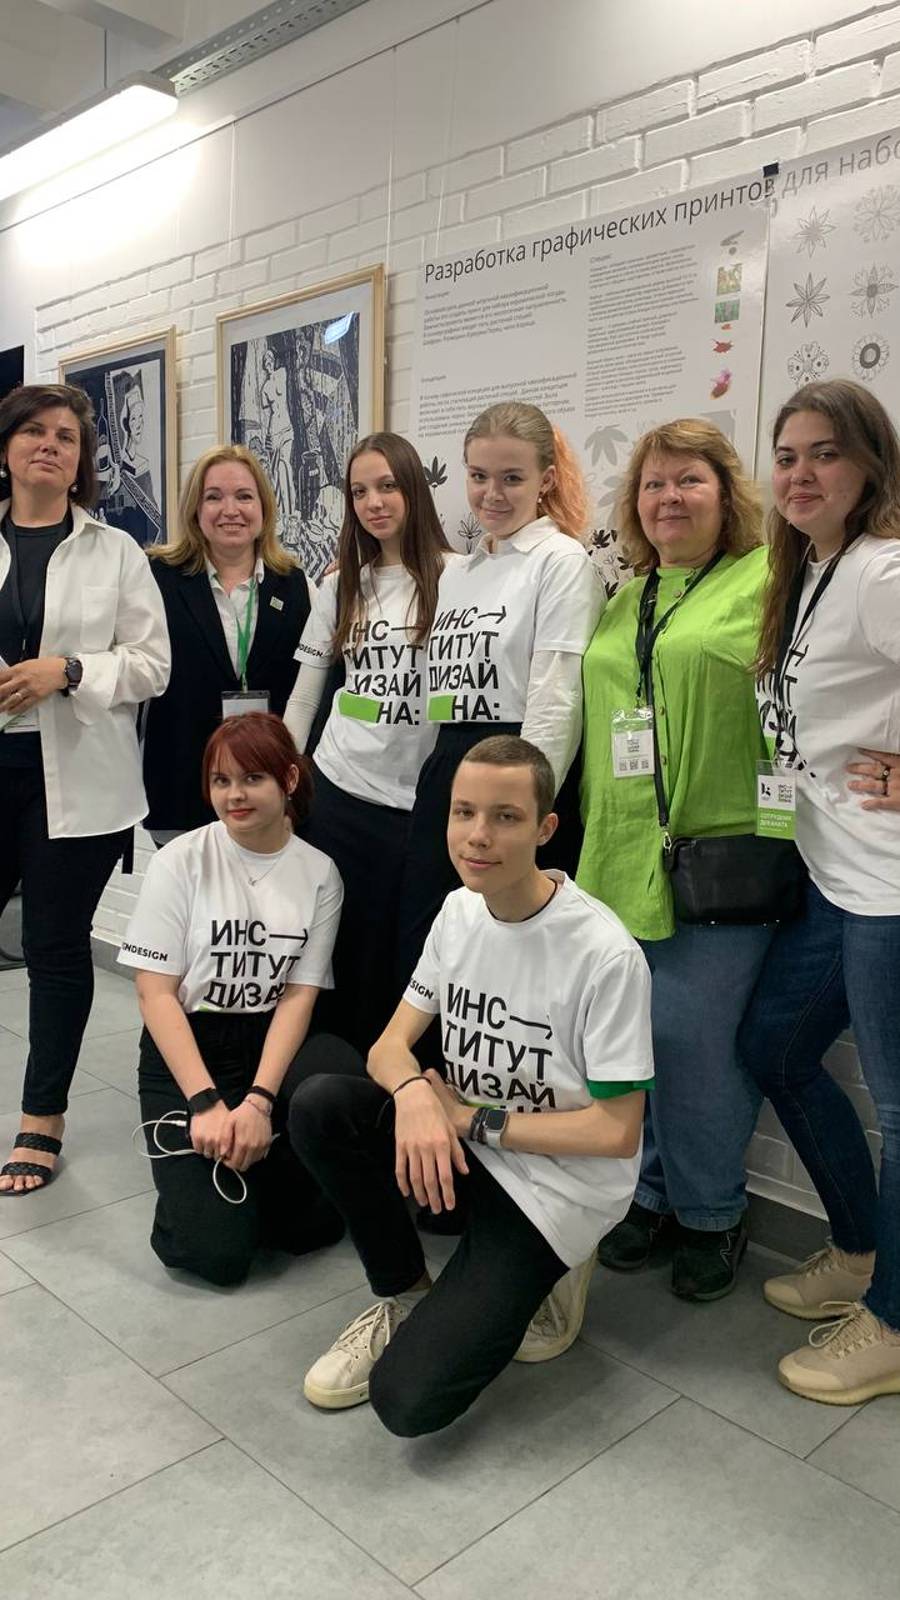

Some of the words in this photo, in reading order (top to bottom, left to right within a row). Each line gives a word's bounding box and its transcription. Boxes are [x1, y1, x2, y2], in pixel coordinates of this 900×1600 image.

[425, 244, 526, 284] Разработка
[532, 207, 667, 263] графических
[674, 177, 776, 225] принтов
[782, 160, 829, 200] для
[433, 606, 479, 632] ИНС
[347, 669, 421, 698] ИЗАЙ
[429, 658, 500, 692] ДИЗАЙ
[376, 700, 420, 726] НА:
[450, 694, 501, 721] НА:
[210, 919, 267, 947] ИНС
[210, 950, 302, 980] ТИТУТ
[203, 980, 285, 1009] ДИЗА
[410, 976, 435, 1000] SIGN
[447, 982, 507, 1030] ИНС
[443, 1019, 553, 1081] ТИТУТ
